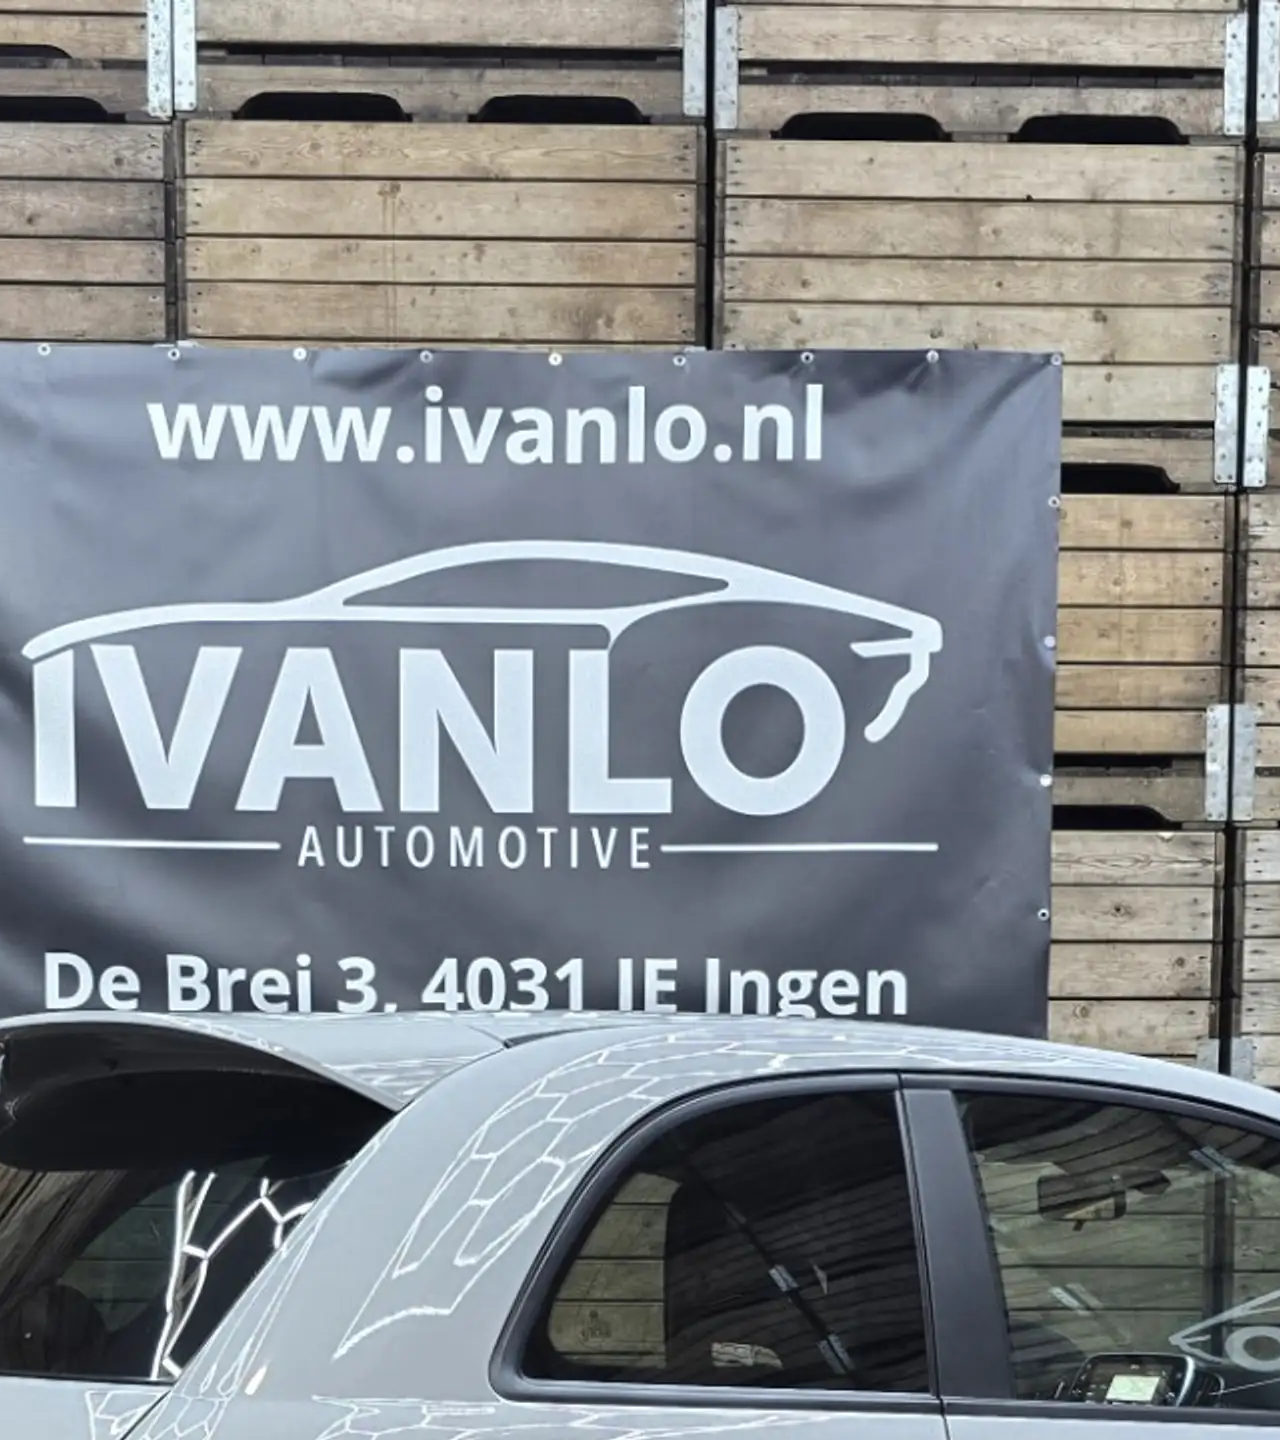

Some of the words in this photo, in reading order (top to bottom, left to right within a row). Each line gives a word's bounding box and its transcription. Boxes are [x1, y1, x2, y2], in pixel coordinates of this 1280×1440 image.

[148, 384, 824, 465] www.ivanlo.nl
[32, 644, 846, 817] IVANLO
[297, 824, 651, 869] AUTOMOTIVE
[43, 951, 140, 1010] De
[166, 953, 313, 1013] Brei
[335, 956, 398, 1014] 3,
[421, 956, 584, 1013] 4031
[705, 957, 908, 1018] Ingen
